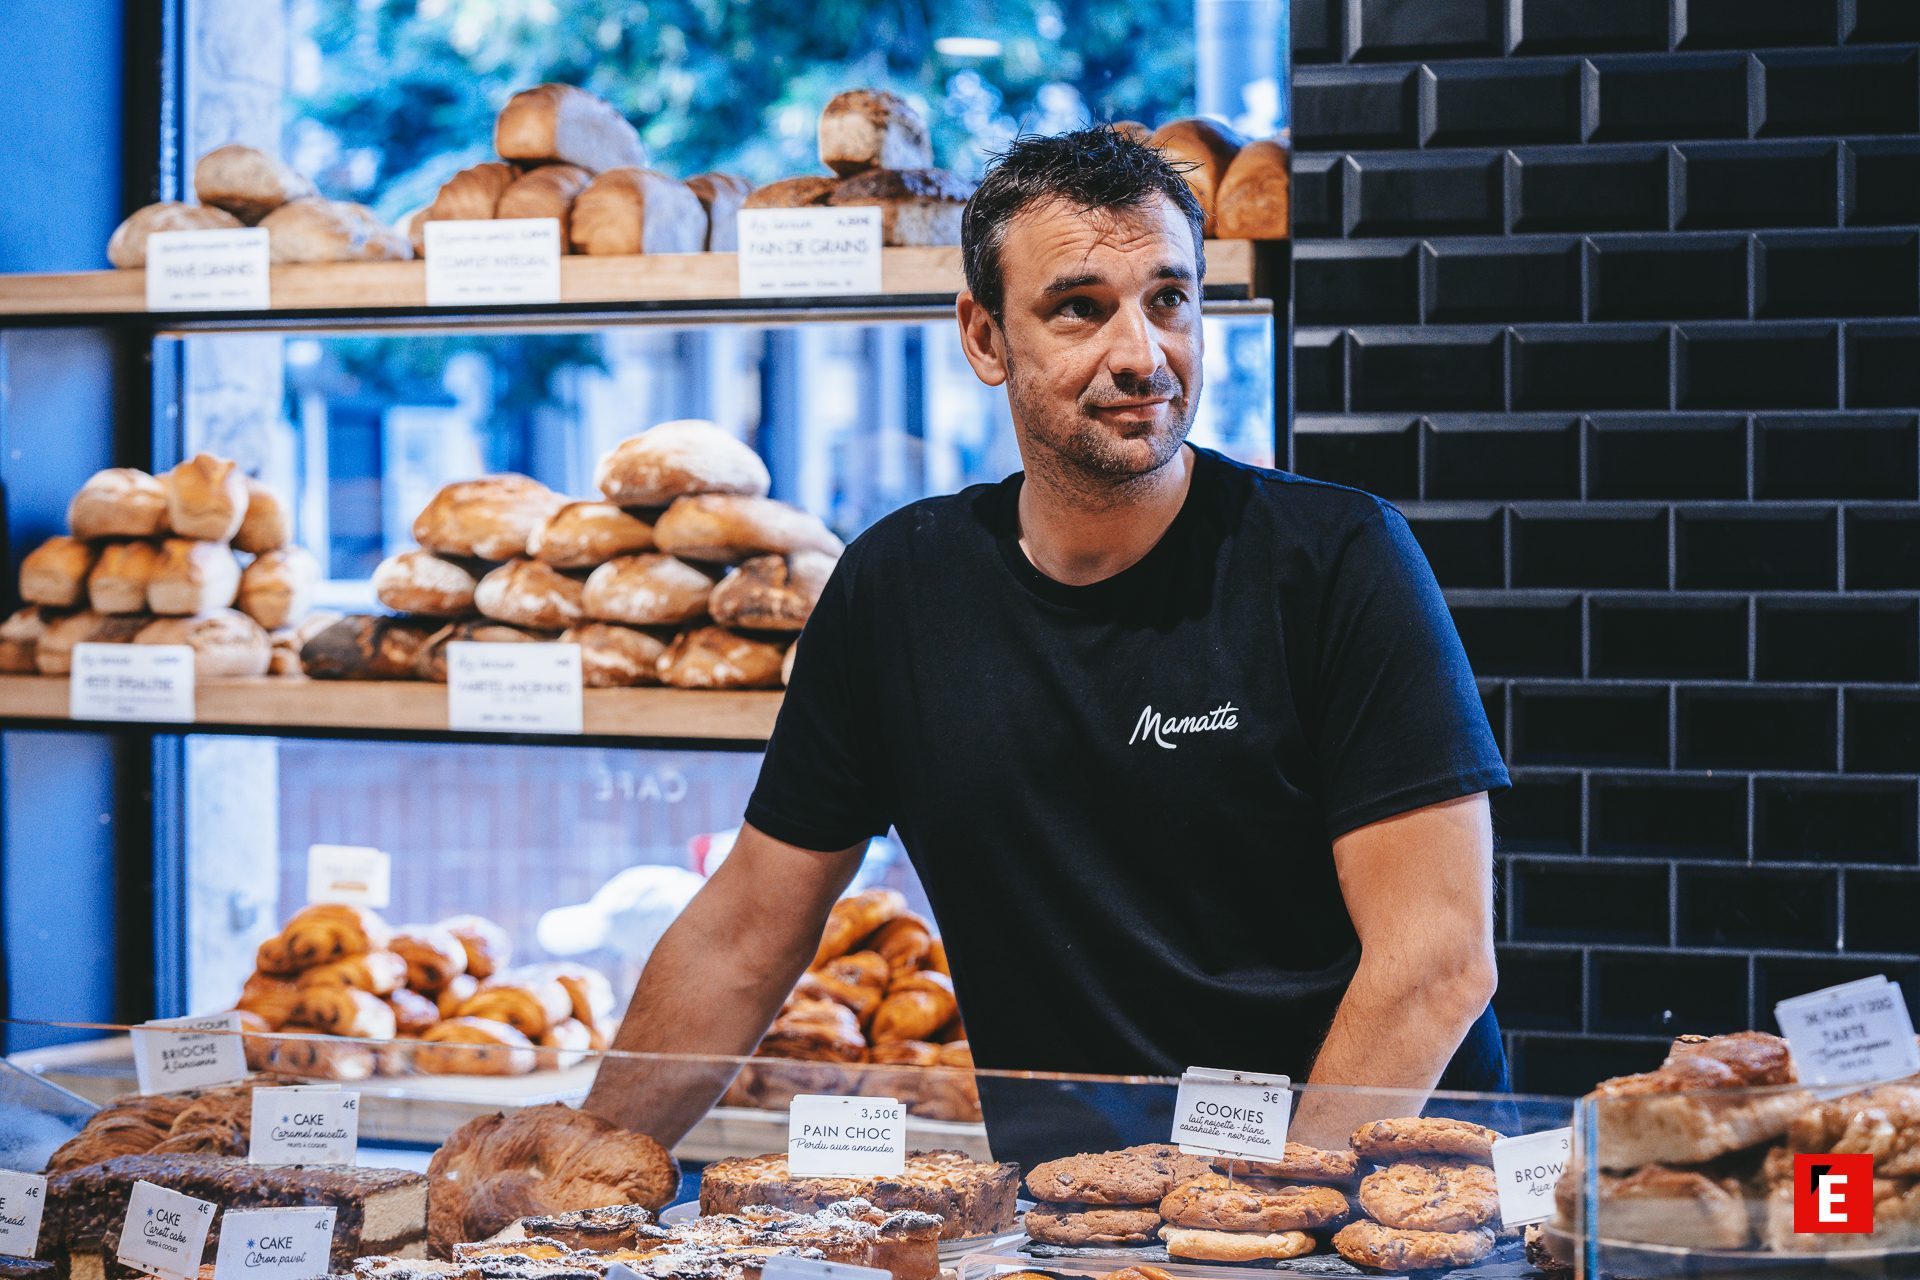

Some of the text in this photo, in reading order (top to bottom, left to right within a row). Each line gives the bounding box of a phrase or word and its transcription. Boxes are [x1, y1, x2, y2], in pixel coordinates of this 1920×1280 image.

[1129, 701, 1239, 749] Mamatte
[162, 1043, 217, 1060] BRIOCHE
[342, 1099, 356, 1110] 4€
[1262, 1091, 1279, 1104] 3€
[293, 1113, 324, 1126] CAKE
[861, 1108, 899, 1121] 3,50€
[1195, 1101, 1265, 1124] COOKIES
[803, 1124, 891, 1140] PAIN CHOC
[1180, 1123, 1220, 1137] cacahuète
[1227, 1131, 1246, 1142] noir
[1188, 1114, 1204, 1125] lait
[1204, 1118, 1236, 1131] noisette
[1242, 1123, 1265, 1136] blanc
[271, 1126, 349, 1142] Caramel noisette
[790, 1137, 895, 1153] Perdu aux amandes
[1561, 1138, 1570, 1150] 3
[1515, 1161, 1564, 1183] BROW
[26, 1187, 39, 1198] 4€
[198, 1203, 211, 1215] 4€
[156, 1208, 182, 1227] CAKE
[315, 1219, 329, 1230] 4€
[143, 1220, 187, 1244] Carott cake
[259, 1236, 293, 1250] CAKE
[244, 1251, 307, 1268] Citron pavot
